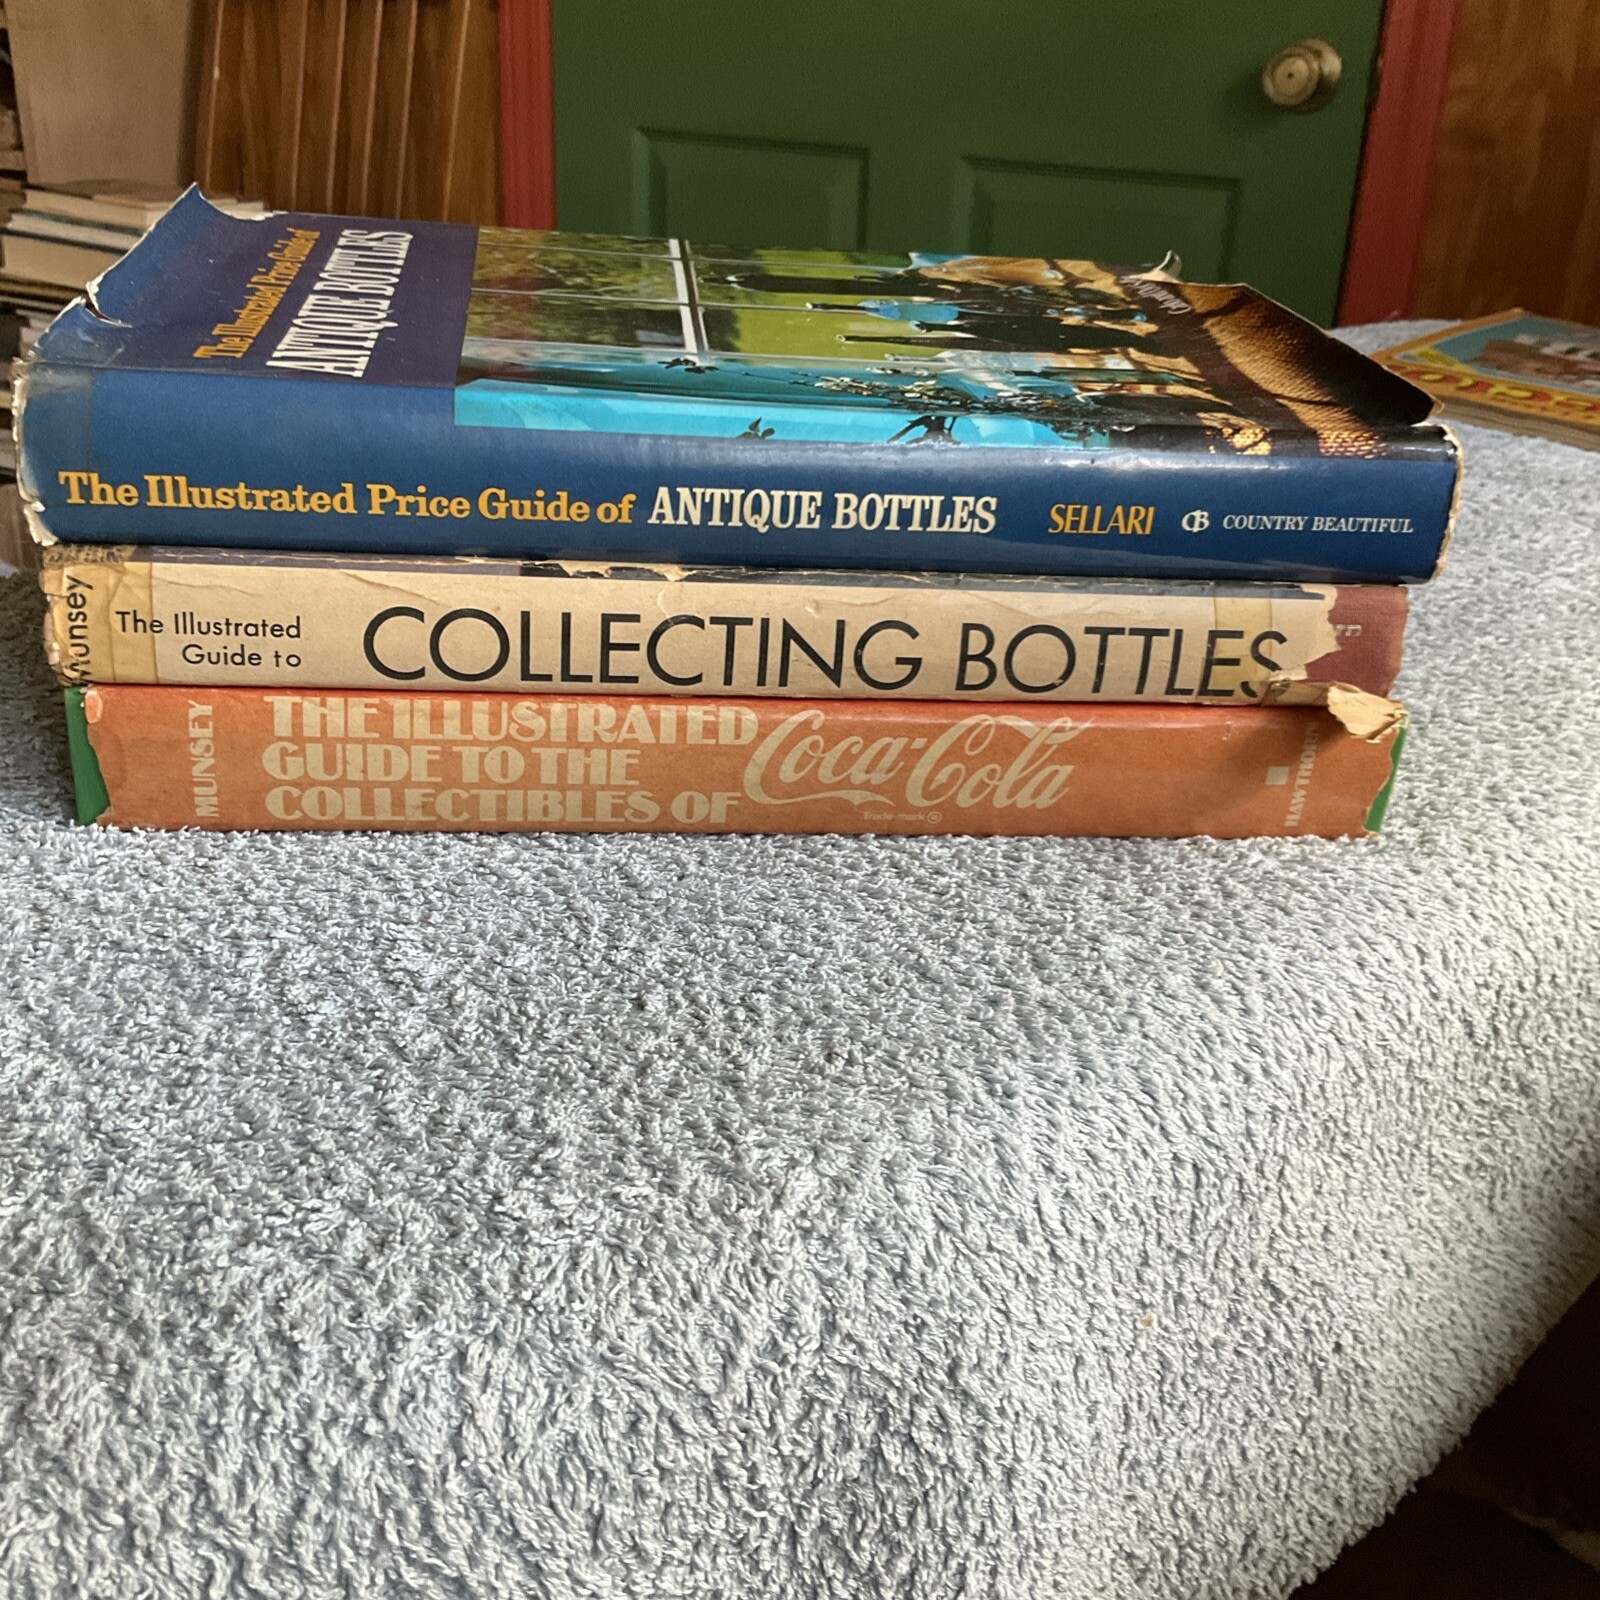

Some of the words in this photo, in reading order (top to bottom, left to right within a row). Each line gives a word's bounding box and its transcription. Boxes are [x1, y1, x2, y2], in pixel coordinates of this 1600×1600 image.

[250, 261, 302, 286] Price
[313, 229, 414, 296] BOTTLES
[211, 284, 288, 337] Illustrated
[193, 337, 254, 358] The
[266, 294, 398, 377] ANTIQUE
[59, 470, 139, 507] The
[144, 475, 358, 515] Illustrated
[366, 483, 471, 518] Price
[478, 487, 590, 523] Guide
[596, 493, 637, 524] of
[647, 486, 823, 533] ANTIQUE
[831, 492, 997, 534] BOTTLES
[1048, 504, 1156, 535] SELLARI
[1222, 514, 1309, 533] COUNTRY
[1311, 515, 1414, 534] BEAUTIFUL
[115, 609, 164, 634] The
[174, 611, 302, 639] Illustrated
[181, 643, 263, 667] Guide
[273, 651, 302, 668] to
[363, 605, 923, 691] COLLECTING
[955, 622, 1288, 699] BOTTLES
[263, 695, 380, 740] THE
[391, 696, 759, 746] ILLUSTRATED
[188, 699, 220, 818] MUNSEY
[261, 741, 444, 783] GUIDE
[452, 745, 525, 783] TO
[531, 747, 641, 786] THE
[743, 710, 1095, 809] Coca-Cola
[265, 785, 661, 823] COLLECTIBLES
[671, 790, 744, 824] OF
